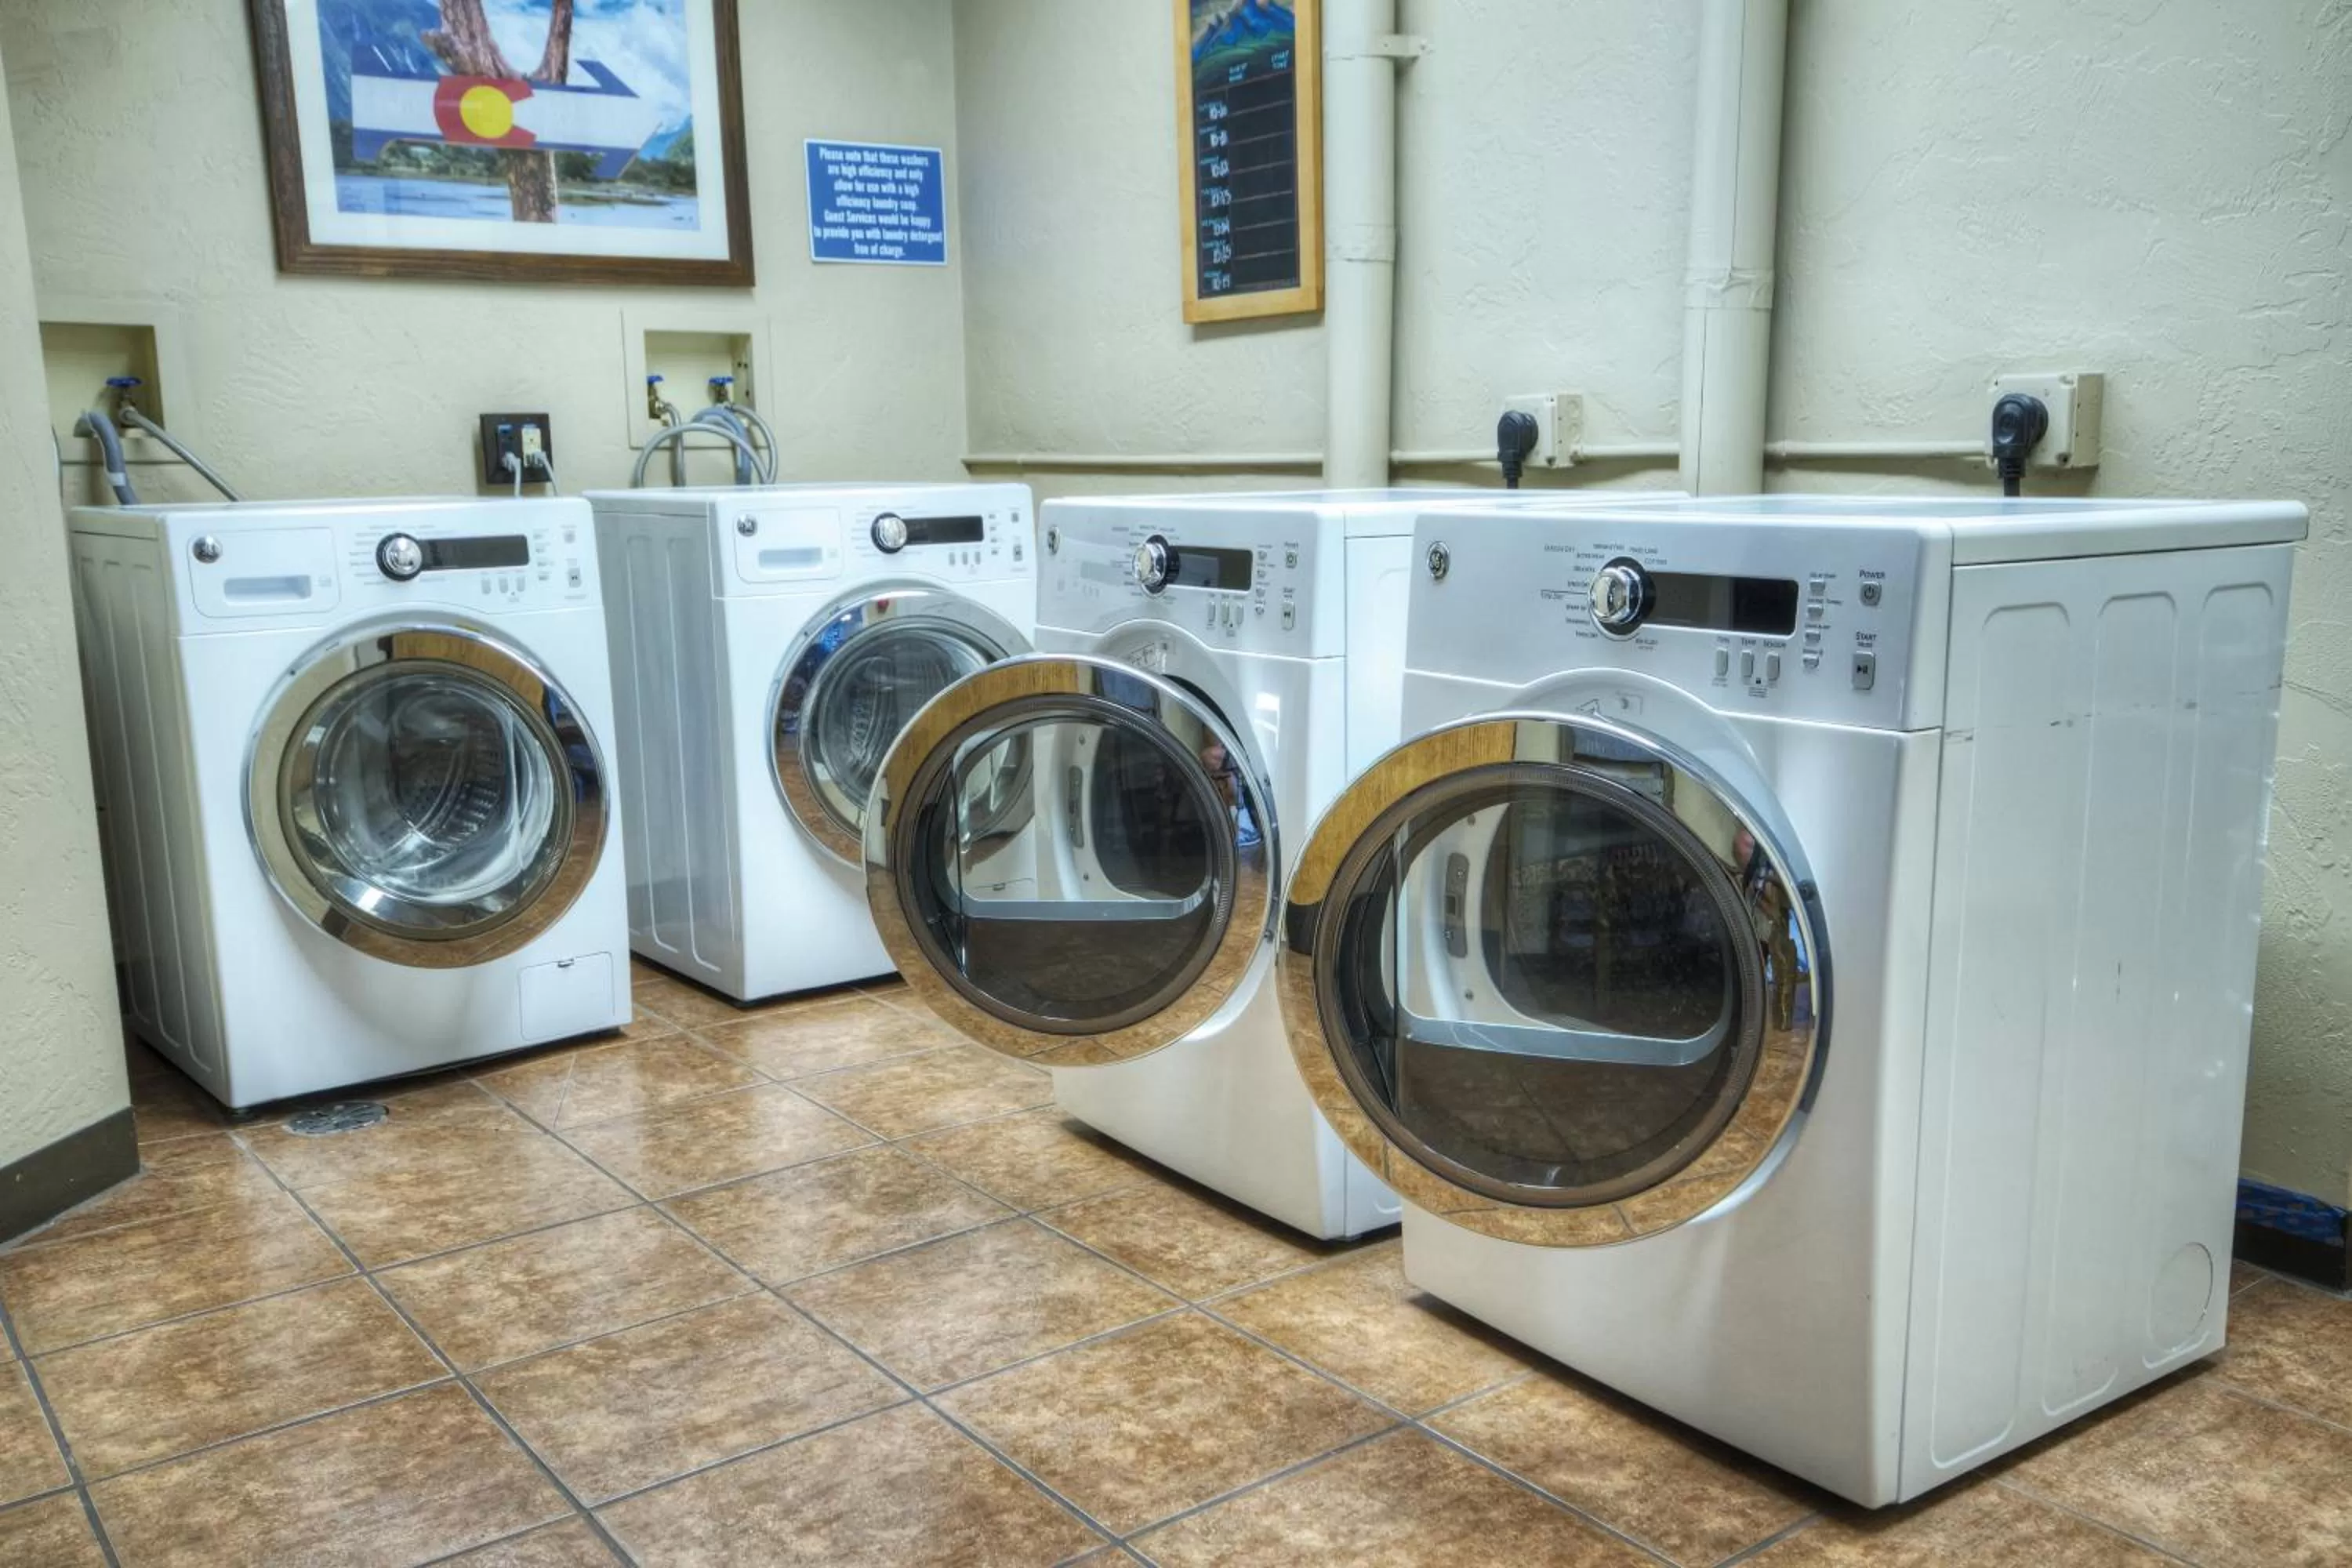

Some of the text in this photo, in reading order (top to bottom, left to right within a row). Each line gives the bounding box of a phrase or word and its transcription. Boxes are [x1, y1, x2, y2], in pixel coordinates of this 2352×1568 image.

[819, 147, 844, 160] Please
[845, 151, 861, 162] note
[863, 151, 878, 162] that
[880, 151, 898, 164] these
[828, 165, 839, 175] are
[840, 164, 856, 179] high
[895, 169, 907, 179] and
[909, 169, 923, 183] only
[855, 180, 864, 192] for
[866, 183, 879, 193] use
[880, 183, 896, 193] with
[904, 183, 919, 198] high
[873, 197, 898, 212] laundry
[825, 209, 844, 223] Guest
[847, 210, 877, 223] Services
[878, 213, 899, 225] would
[900, 213, 909, 225] be
[814, 226, 822, 238] to
[823, 227, 849, 241] provide
[851, 230, 864, 241] you
[866, 228, 881, 239] with
[883, 229, 907, 243] laundry
[855, 242, 869, 255] free
[870, 244, 878, 255] of
[1859, 570, 1886, 579] POWER
[1856, 632, 1877, 641] START
